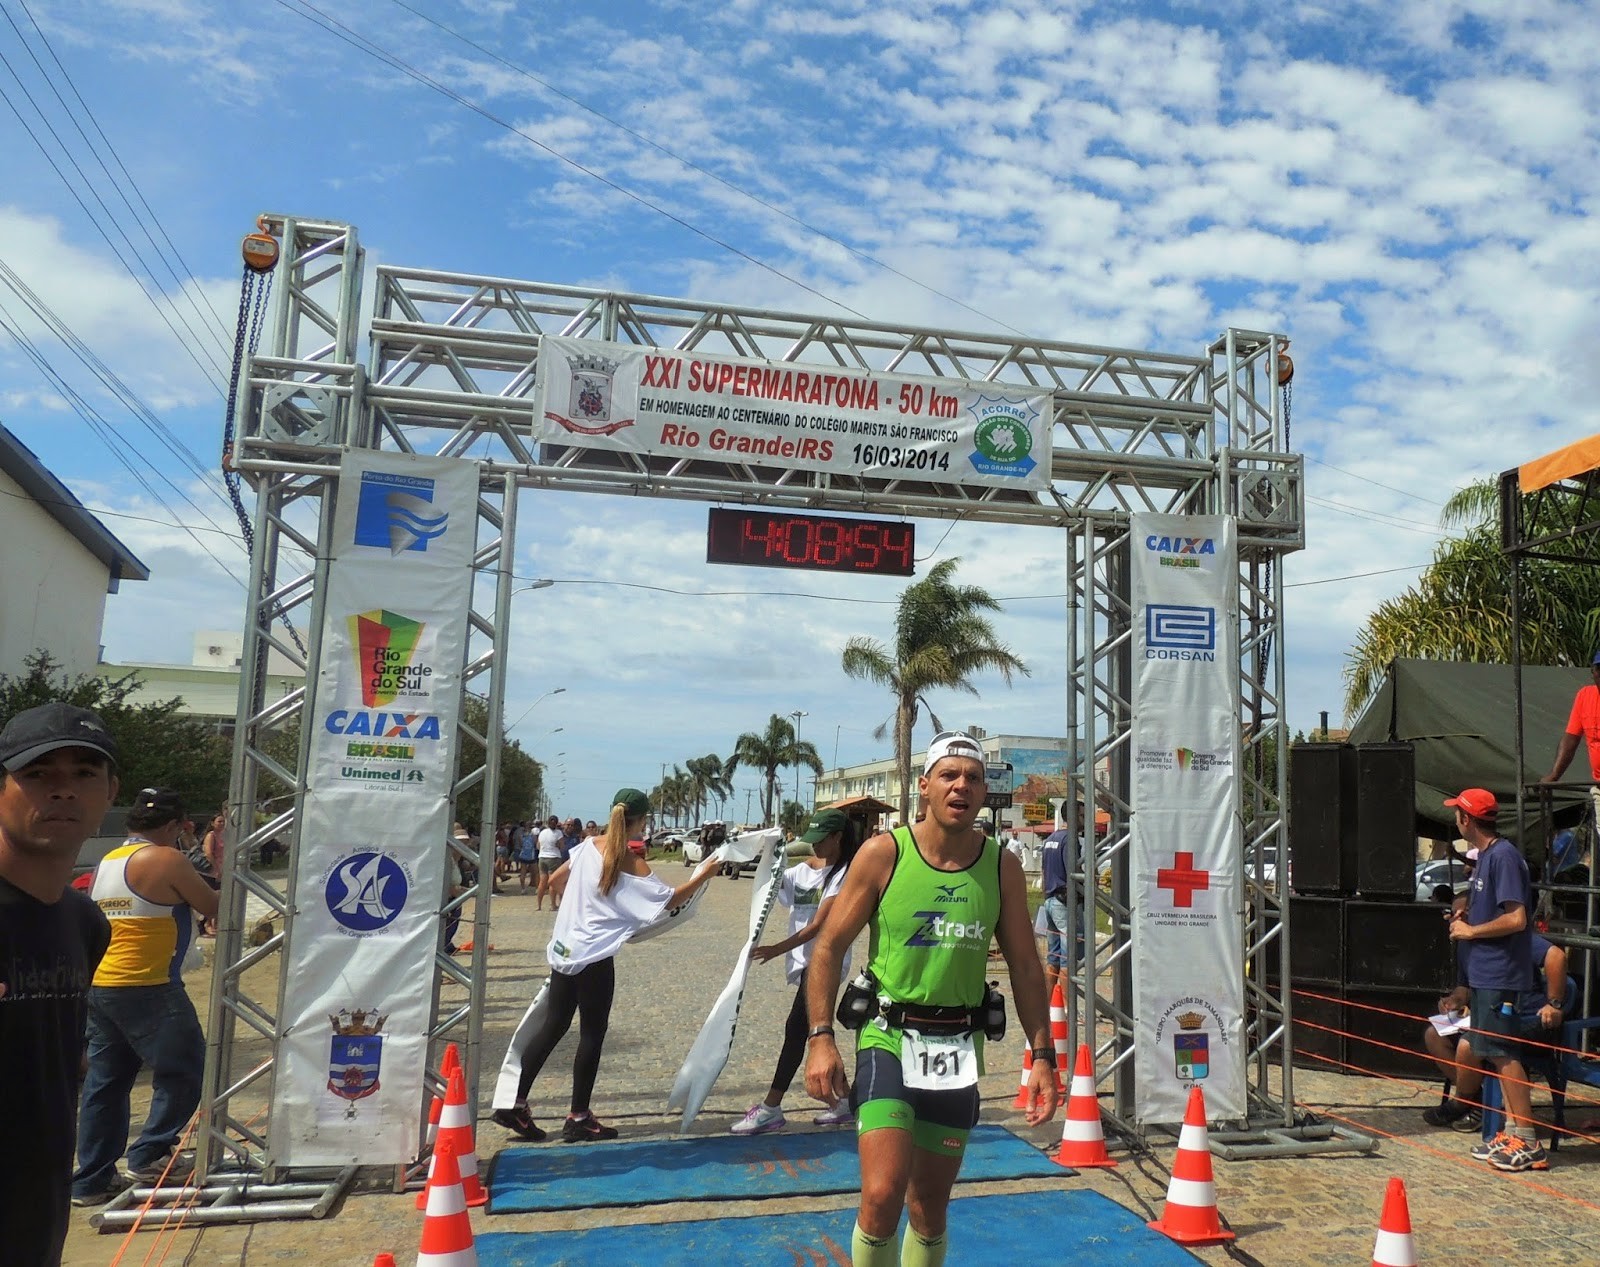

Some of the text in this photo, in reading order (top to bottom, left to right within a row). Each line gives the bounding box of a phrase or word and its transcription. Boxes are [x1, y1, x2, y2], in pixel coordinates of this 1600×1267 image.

[640, 355, 682, 390] XXI
[688, 360, 879, 411] SUPERMARATONA
[898, 383, 923, 415] 50
[929, 387, 958, 418] km
[639, 398, 958, 443] EM HOMENAGEM AO CENTENÁRIO DO COLÉGIO MARISTA SÃO FRANCISCO
[981, 405, 1026, 419] ACORRG
[660, 423, 950, 471] Rio Grande/RS 16/03/2014
[363, 471, 383, 481] Porto
[407, 477, 433, 487] Grande
[745, 518, 911, 567] 4:08:54
[1145, 535, 1215, 554] CAIXA
[1160, 556, 1200, 567] BRASIL
[374, 647, 401, 662] Rio
[1146, 649, 1215, 662] CORSAN
[372, 660, 433, 677] Grande
[371, 674, 421, 690] do Sul
[325, 710, 441, 740] CAIXA
[346, 743, 415, 760] BRASIL
[1191, 752, 1217, 760] Governo
[341, 766, 401, 780] Unimed
[364, 783, 400, 792] Litoral Sul
[352, 846, 380, 854] Amigos
[388, 851, 398, 859] do
[401, 861, 415, 889] Cassino
[336, 925, 348, 935] Rio
[348, 930, 374, 938] Grande
[378, 927, 390, 935] RS
[1164, 996, 1194, 1018] MARQUÊS
[1194, 997, 1204, 1006] DE
[918, 1050, 960, 1077] 161
